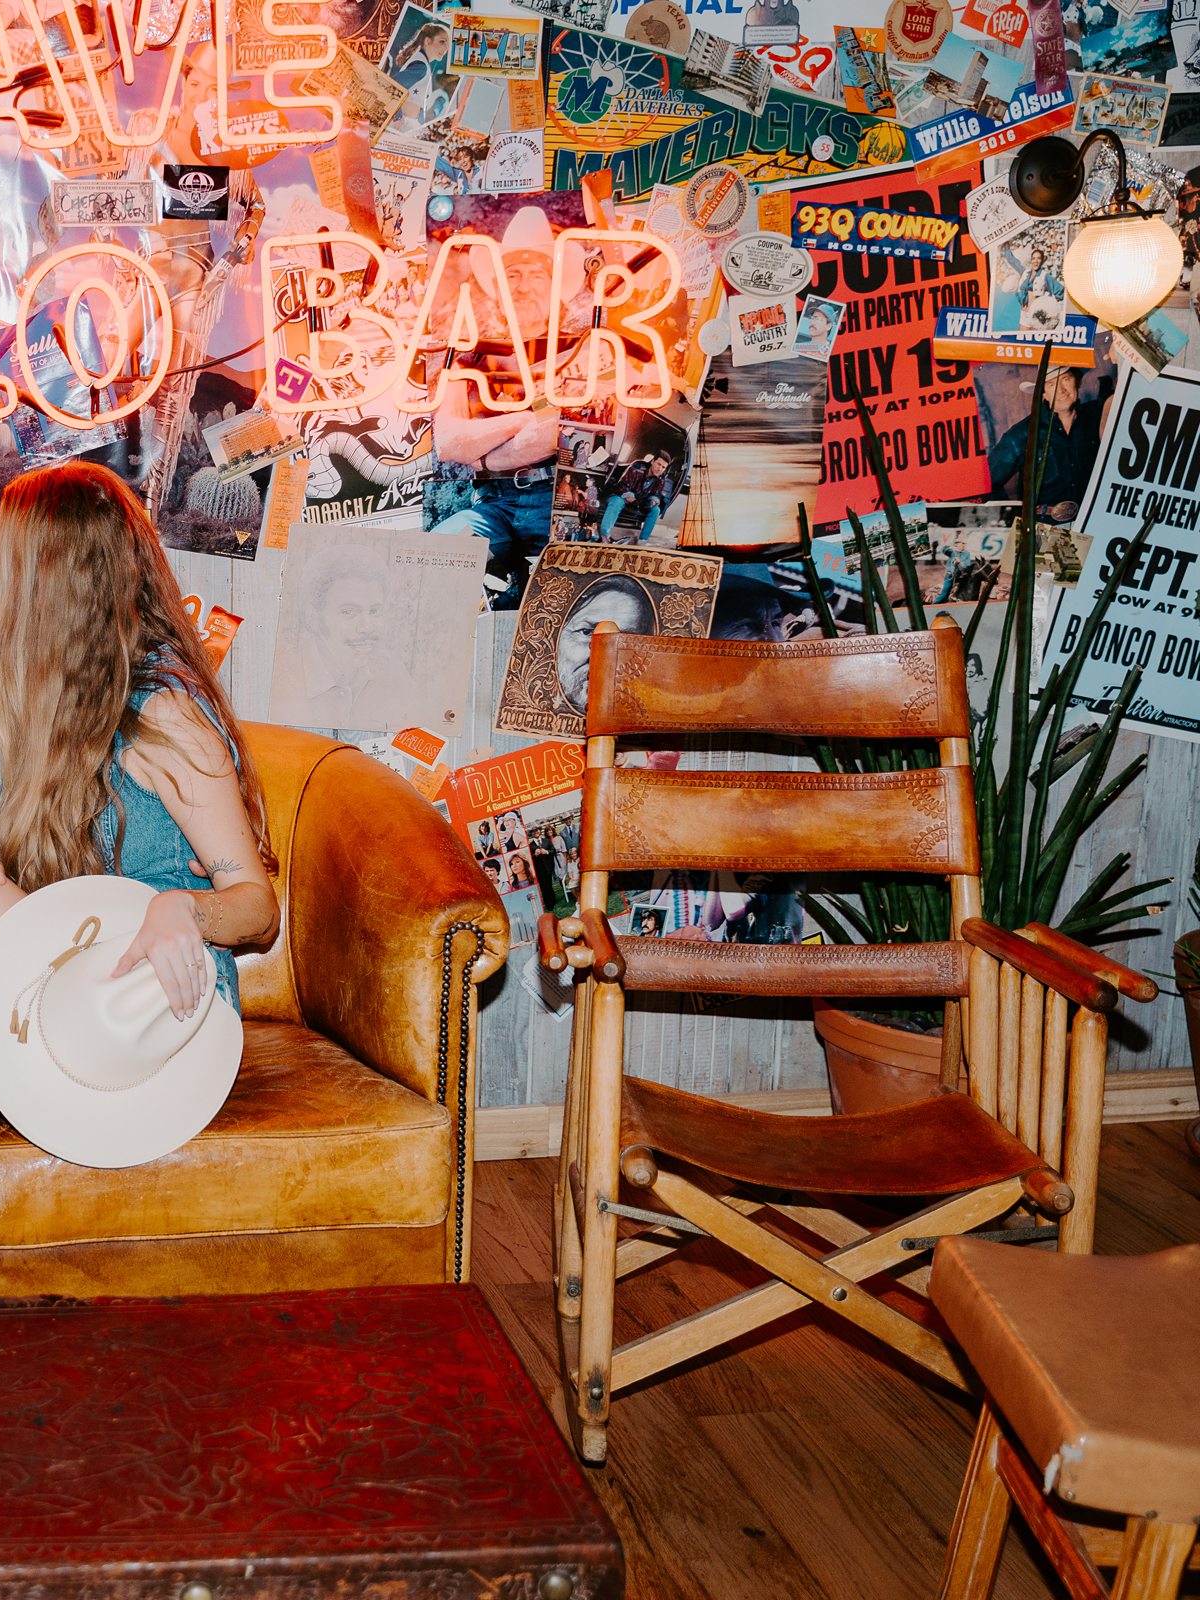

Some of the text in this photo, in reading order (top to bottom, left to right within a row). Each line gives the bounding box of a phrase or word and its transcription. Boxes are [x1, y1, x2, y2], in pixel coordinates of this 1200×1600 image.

[563, 8, 598, 23] BUTTER
[666, 5, 686, 31] TEXAS
[907, 13, 933, 25] LONE
[905, 22, 931, 34] STAR
[999, 32, 1016, 43] DAILY
[452, 28, 538, 70] TEXAS
[887, 20, 902, 53] certified
[896, 50, 930, 60] premium
[1036, 39, 1063, 56] STATE
[558, 76, 613, 113] M
[625, 86, 684, 103] DALLAS
[249, 110, 279, 121] LEADER
[614, 99, 705, 118] MAVERICKS
[1079, 92, 1166, 130] TEXAS
[915, 89, 1065, 155] Willie elson
[522, 136, 542, 156] COWBOY
[555, 101, 863, 200] MAVERICKS
[819, 143, 831, 152] 55
[979, 130, 1016, 153] 2016
[383, 161, 413, 175] FORTY
[400, 155, 430, 170] DALLAS
[492, 178, 502, 188] YOU
[502, 178, 519, 188] AIN'T
[60, 194, 97, 213] CHEF
[695, 172, 738, 228] Budweiser
[77, 204, 147, 224] RODEO QUEEN
[798, 205, 960, 249] 93Q COUNTRY
[757, 240, 783, 250] COUPON
[827, 241, 921, 258] HOUSTON
[864, 289, 926, 330] PARTY
[929, 280, 981, 319] TOUR
[261, 228, 682, 414] BAR
[739, 304, 787, 334] YOUNG
[743, 325, 788, 346] COUNTRY
[759, 342, 784, 352] 95.7
[996, 345, 1033, 358] 2016
[1112, 335, 1140, 364] DALLAS
[277, 366, 306, 396] T
[826, 344, 897, 404] ULY
[756, 391, 812, 403] Panhandle
[775, 383, 795, 395] The
[884, 387, 976, 414] AT 10PM
[917, 415, 987, 467] BOWL
[1105, 482, 1200, 531] THE QUEEN
[545, 548, 718, 585] WILLIE NELSON
[1100, 537, 1197, 599] SEPT.
[1153, 595, 1178, 614] AT
[1060, 614, 1155, 669] BONCO
[503, 709, 555, 732] TOUGHER
[396, 732, 441, 760] DALLAS
[463, 767, 475, 775] TV's
[465, 743, 585, 808] DALLAS
[492, 799, 512, 811] Game
[520, 792, 532, 802] the
[532, 786, 553, 801] Ewing
[552, 779, 576, 796] Family
